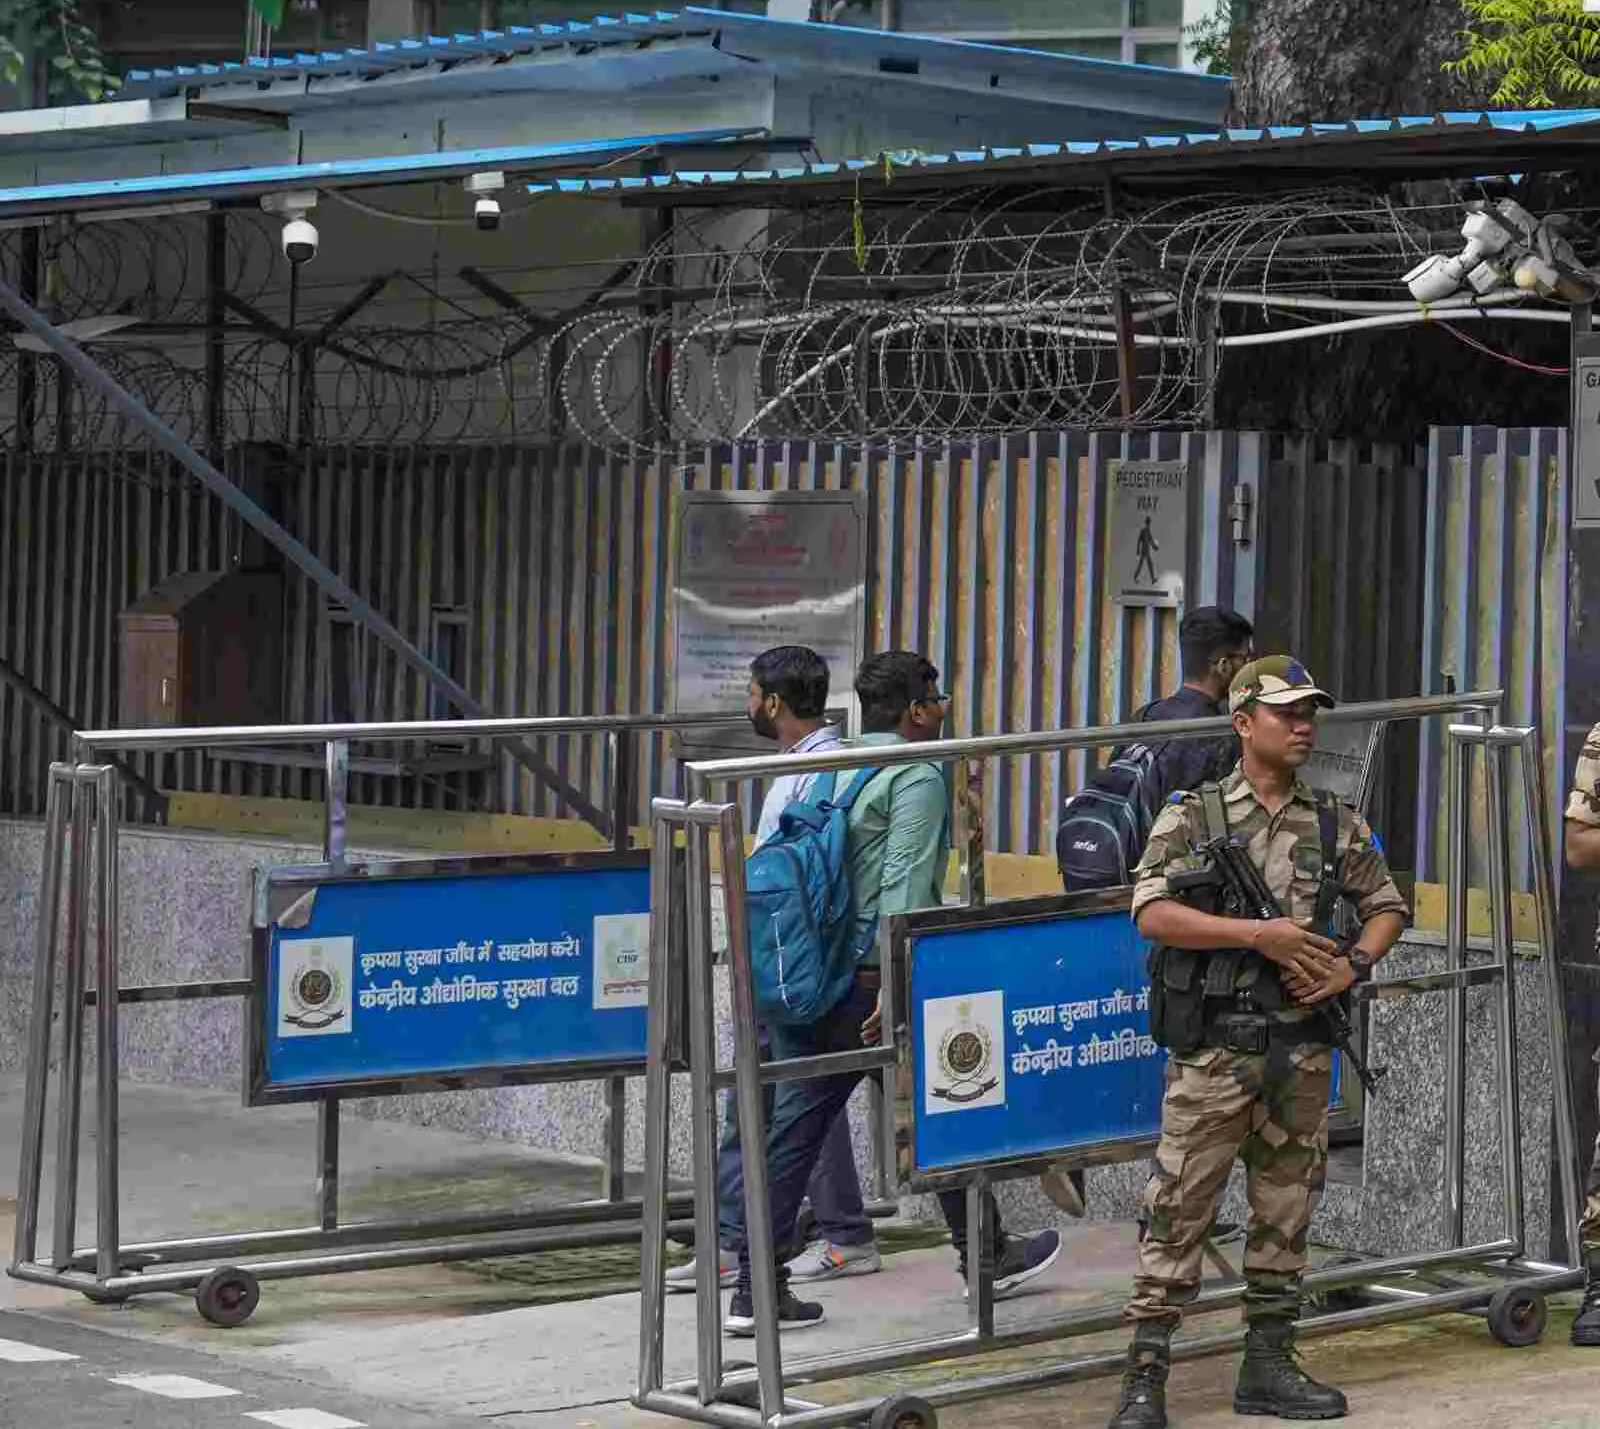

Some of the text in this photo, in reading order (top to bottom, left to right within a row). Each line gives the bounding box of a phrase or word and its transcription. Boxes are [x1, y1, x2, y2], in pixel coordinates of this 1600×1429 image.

[1115, 470, 1183, 490] PEDESTRIAN
[1136, 494, 1160, 511] WAY
[361, 951, 401, 976] कृपया
[404, 950, 442, 975] सुरक्षा
[478, 940, 493, 962] में
[497, 938, 548, 961] सहयोग
[420, 974, 499, 1005] औद्योगिक
[502, 977, 548, 1009] सुरक्षा
[551, 975, 581, 997] बल
[1012, 1005, 1056, 1035] कृपया
[1058, 998, 1099, 1032] सुरक्षा
[1135, 985, 1152, 1011] में
[1077, 1028, 1158, 1067] औद्योगिक
